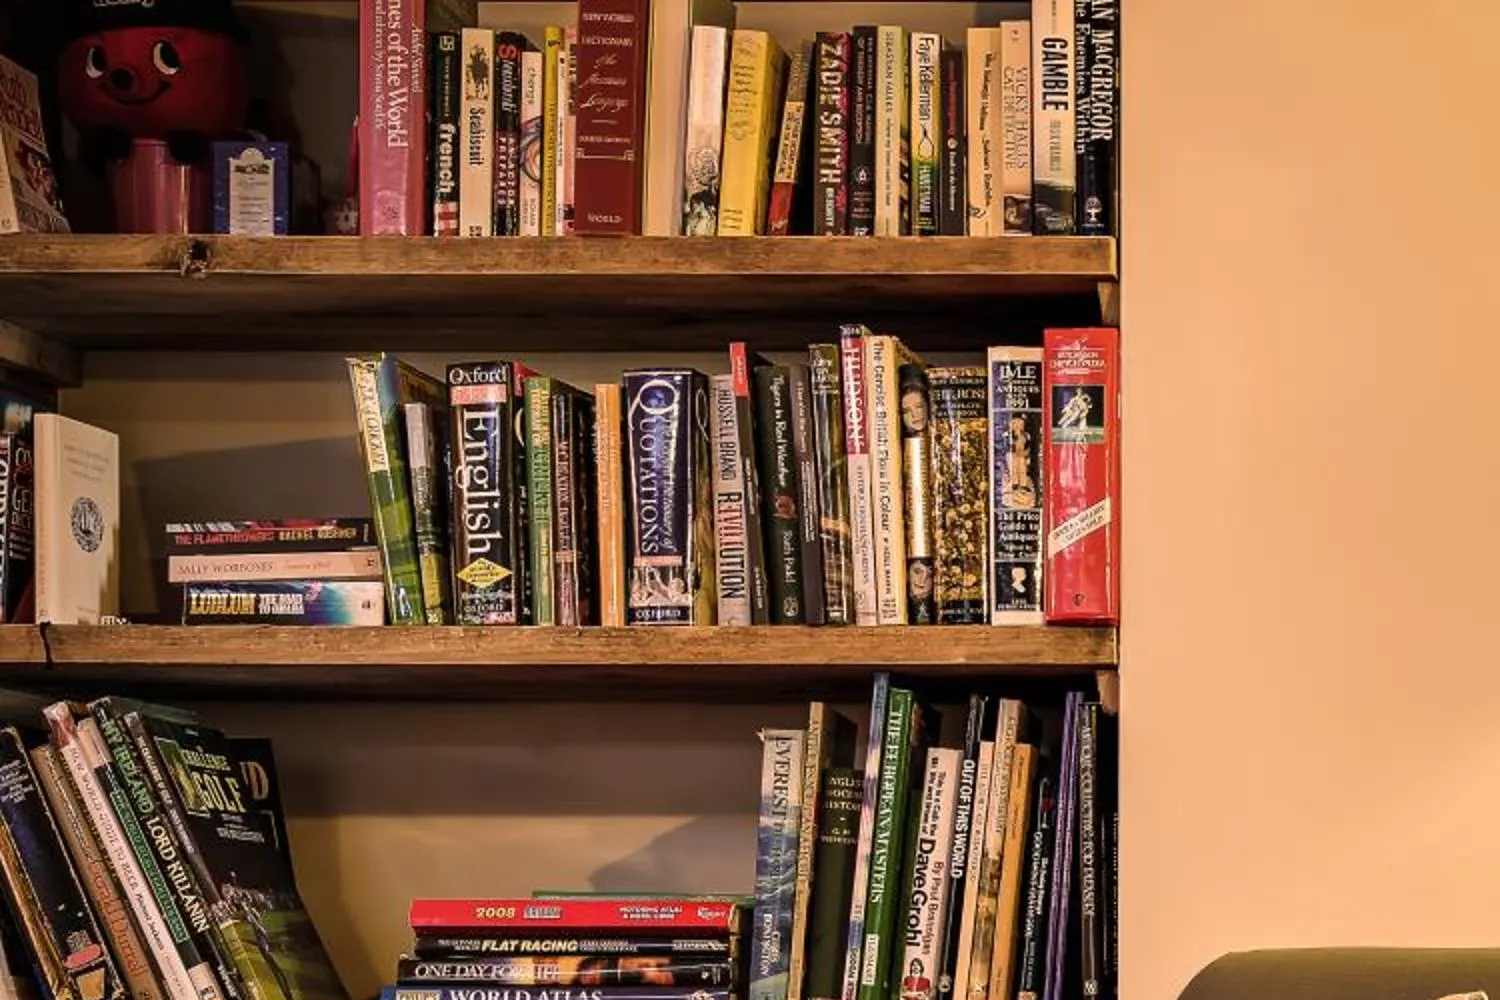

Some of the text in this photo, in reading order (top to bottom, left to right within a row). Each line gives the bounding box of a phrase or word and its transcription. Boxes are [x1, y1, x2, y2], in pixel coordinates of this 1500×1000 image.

[387, 32, 408, 148] of the World
[916, 36, 935, 120] Faye Kellerman
[1003, 66, 1015, 91] CAT
[1041, 37, 1069, 111] GAMBLE
[1075, 0, 1091, 156] he Enemies Within
[469, 107, 486, 166] Seabiscuit
[819, 43, 842, 184] ZADIE SMITH
[1015, 66, 1030, 169] VICKY HALLS
[439, 123, 455, 193] french
[449, 367, 508, 384] Oxford
[872, 342, 885, 360] The
[717, 389, 737, 481] RUSSELL BRAND
[769, 374, 790, 489] Tigers in Red Weather
[875, 411, 889, 447] British
[454, 407, 503, 555] English
[629, 381, 679, 553] QUOTATIONS
[878, 450, 891, 479] Flora
[879, 481, 891, 492] in
[175, 533, 193, 545] THE
[880, 496, 893, 531] Colour
[177, 564, 209, 575] SALLY
[661, 538, 678, 553] of
[190, 592, 257, 615] LUDLUM
[191, 770, 247, 813] GOLF
[771, 736, 796, 820] EVEREST
[871, 709, 903, 904] THE EUROPEAN MASTERS
[936, 771, 946, 788] This
[84, 776, 102, 811] WORLD
[114, 848, 127, 862] TO
[102, 718, 211, 933] MY IRELAND LORD KILLANIN
[950, 758, 976, 879] OUT OF THIS WORLD
[905, 837, 937, 947] Dave Grohl
[929, 877, 943, 901] Paul
[931, 861, 944, 875] By
[475, 907, 516, 919] 2008
[111, 917, 149, 977] Durrell
[415, 963, 488, 979] ONE DAY
[481, 939, 519, 952] FLAT
[520, 939, 579, 952] RACING
